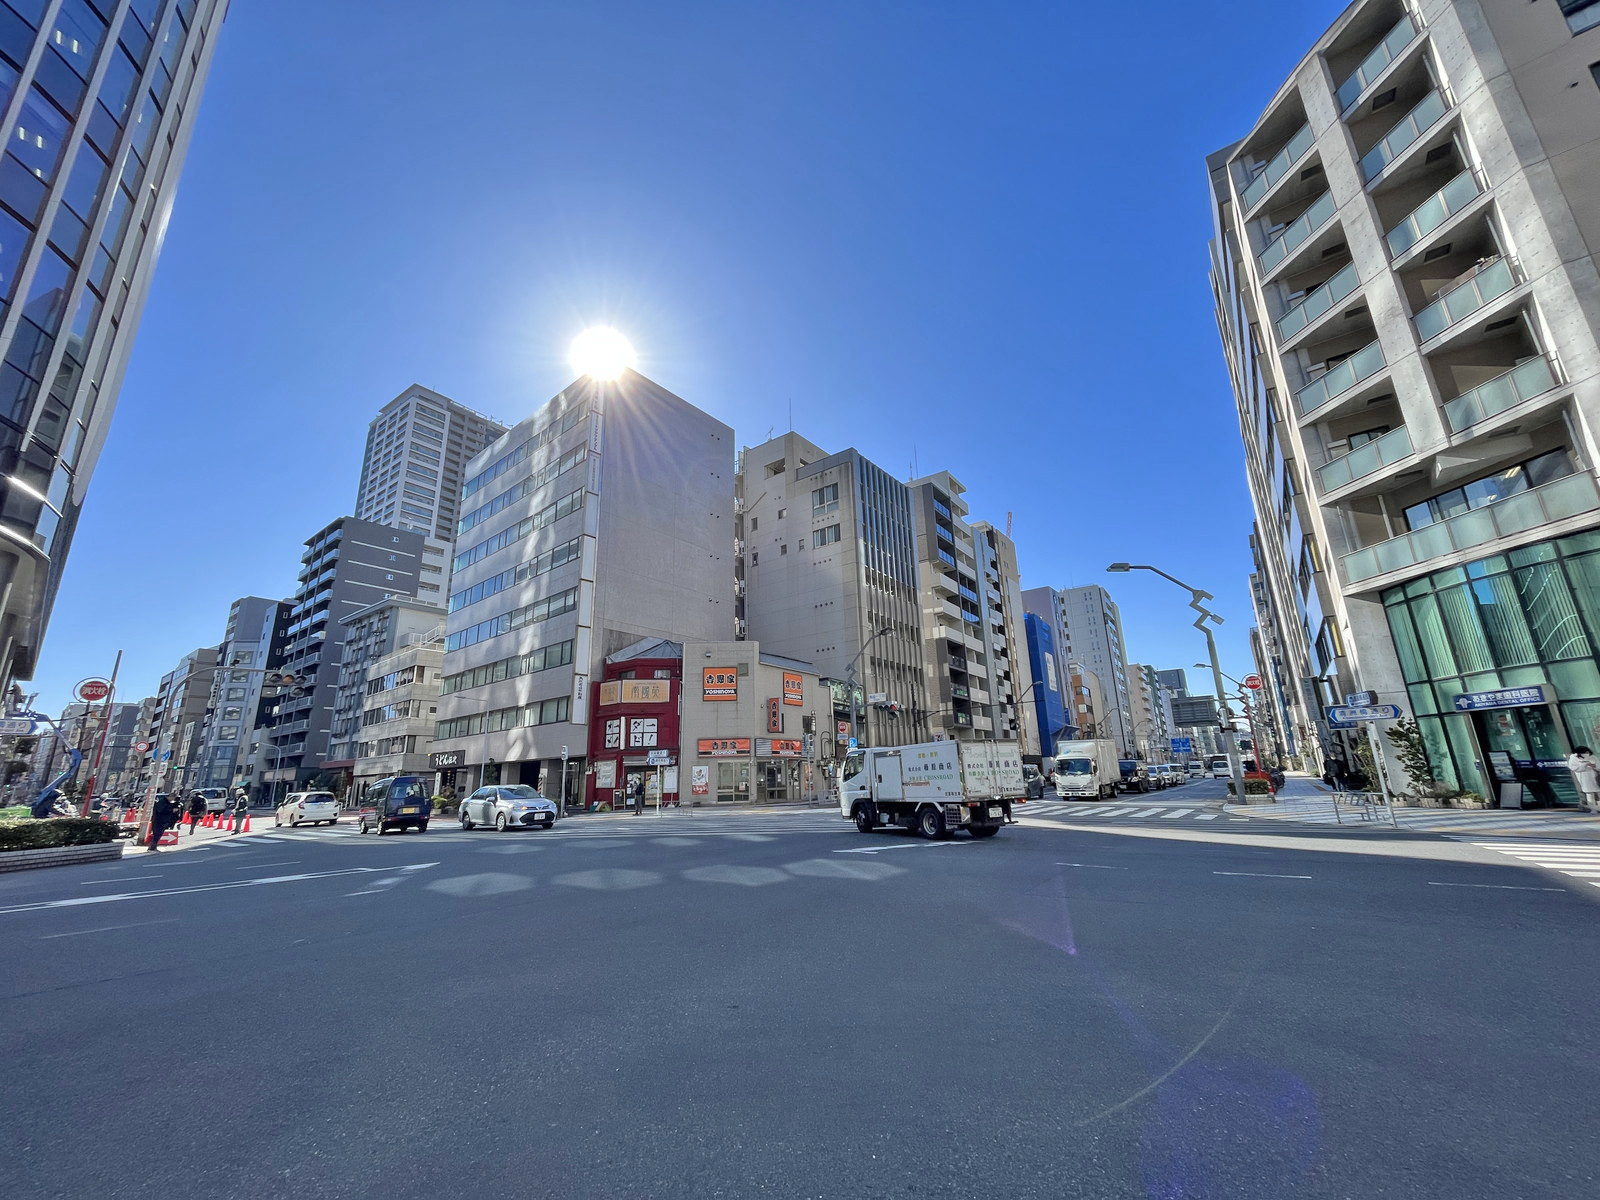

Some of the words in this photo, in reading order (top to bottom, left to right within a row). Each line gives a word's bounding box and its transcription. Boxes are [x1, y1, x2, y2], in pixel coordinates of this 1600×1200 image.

[705, 674, 735, 684] 吉野家
[785, 680, 802, 690] 吉野家
[81, 687, 106, 695] 消火栓
[1472, 688, 1540, 702] あきやま歯科医院
[712, 741, 737, 750] 吉野家
